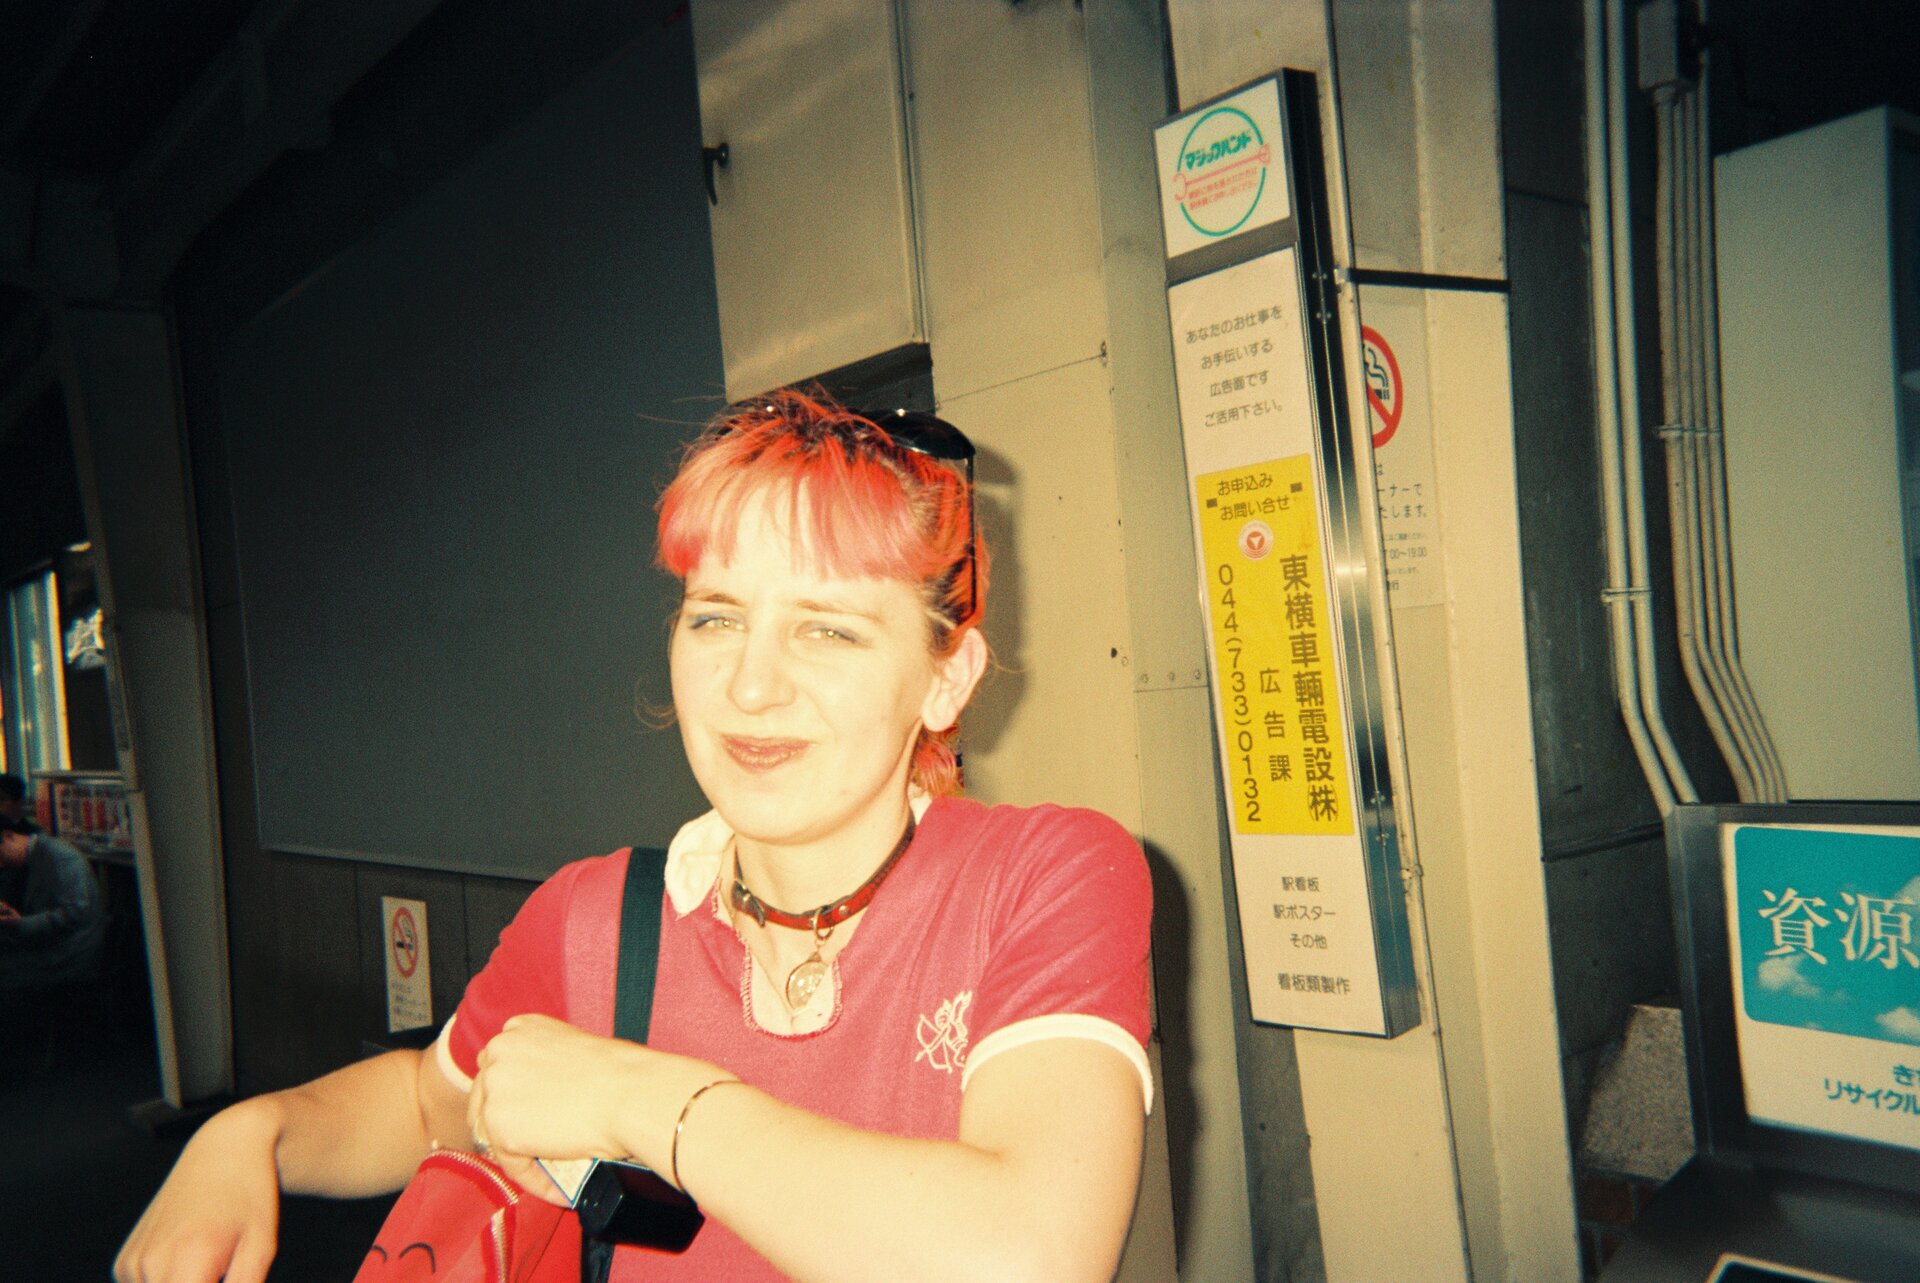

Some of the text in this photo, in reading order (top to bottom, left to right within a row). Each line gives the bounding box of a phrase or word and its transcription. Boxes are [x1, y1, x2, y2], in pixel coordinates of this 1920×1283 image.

[1186, 305, 1282, 344] あなたのお仕事を
[1201, 339, 1273, 370] お手伝いする
[1217, 473, 1273, 496] お申込み
[1220, 495, 1290, 520] お問い合せ
[1259, 667, 1292, 782] 広告課
[1281, 876, 1320, 892] 駅看板
[1273, 904, 1336, 920] 駅ポスター
[1758, 887, 1920, 969] 資源
[1290, 933, 1328, 949] その他
[1277, 972, 1351, 996] 看板類製作
